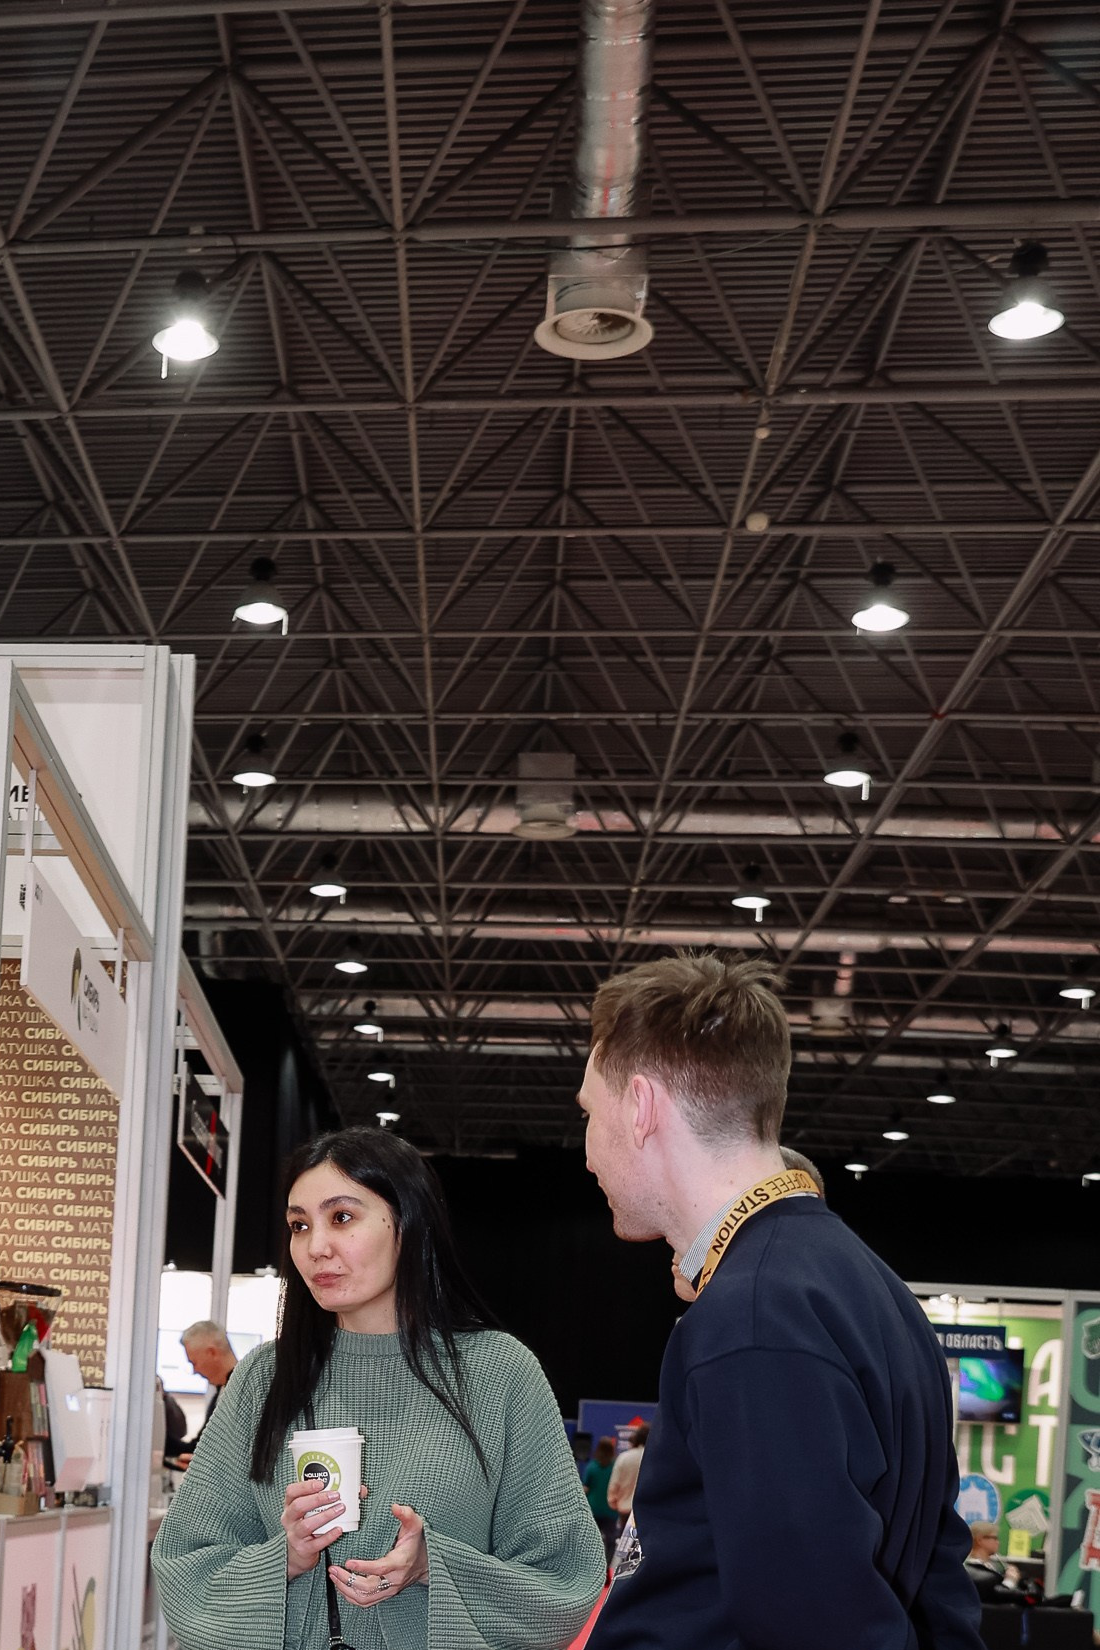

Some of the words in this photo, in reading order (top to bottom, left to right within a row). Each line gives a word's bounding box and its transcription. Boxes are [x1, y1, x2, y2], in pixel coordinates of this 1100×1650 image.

[22, 1059, 83, 1073] СИБИРЬ
[21, 1091, 81, 1104] СИБИРЬ
[58, 1108, 118, 1122] СИБИРЬ
[19, 1123, 79, 1137] СИБИРЬ
[56, 1140, 116, 1154] СИБИРЬ
[18, 1155, 78, 1168] СИБИРЬ
[54, 1172, 115, 1186] СИБИРЬ
[766, 1173, 811, 1197] COFFEE
[16, 1187, 76, 1200] СИБИРЬ
[53, 1204, 113, 1218] СИБИРЬ
[14, 1219, 74, 1232] СИБИРЬ
[712, 1187, 770, 1255] STATION
[51, 1236, 111, 1250] СИБИРЬ
[12, 1251, 72, 1265] СИБИРЬ
[50, 1268, 109, 1282] СИБИРЬ
[946, 1333, 1003, 1351] ОБЛАСТЬ
